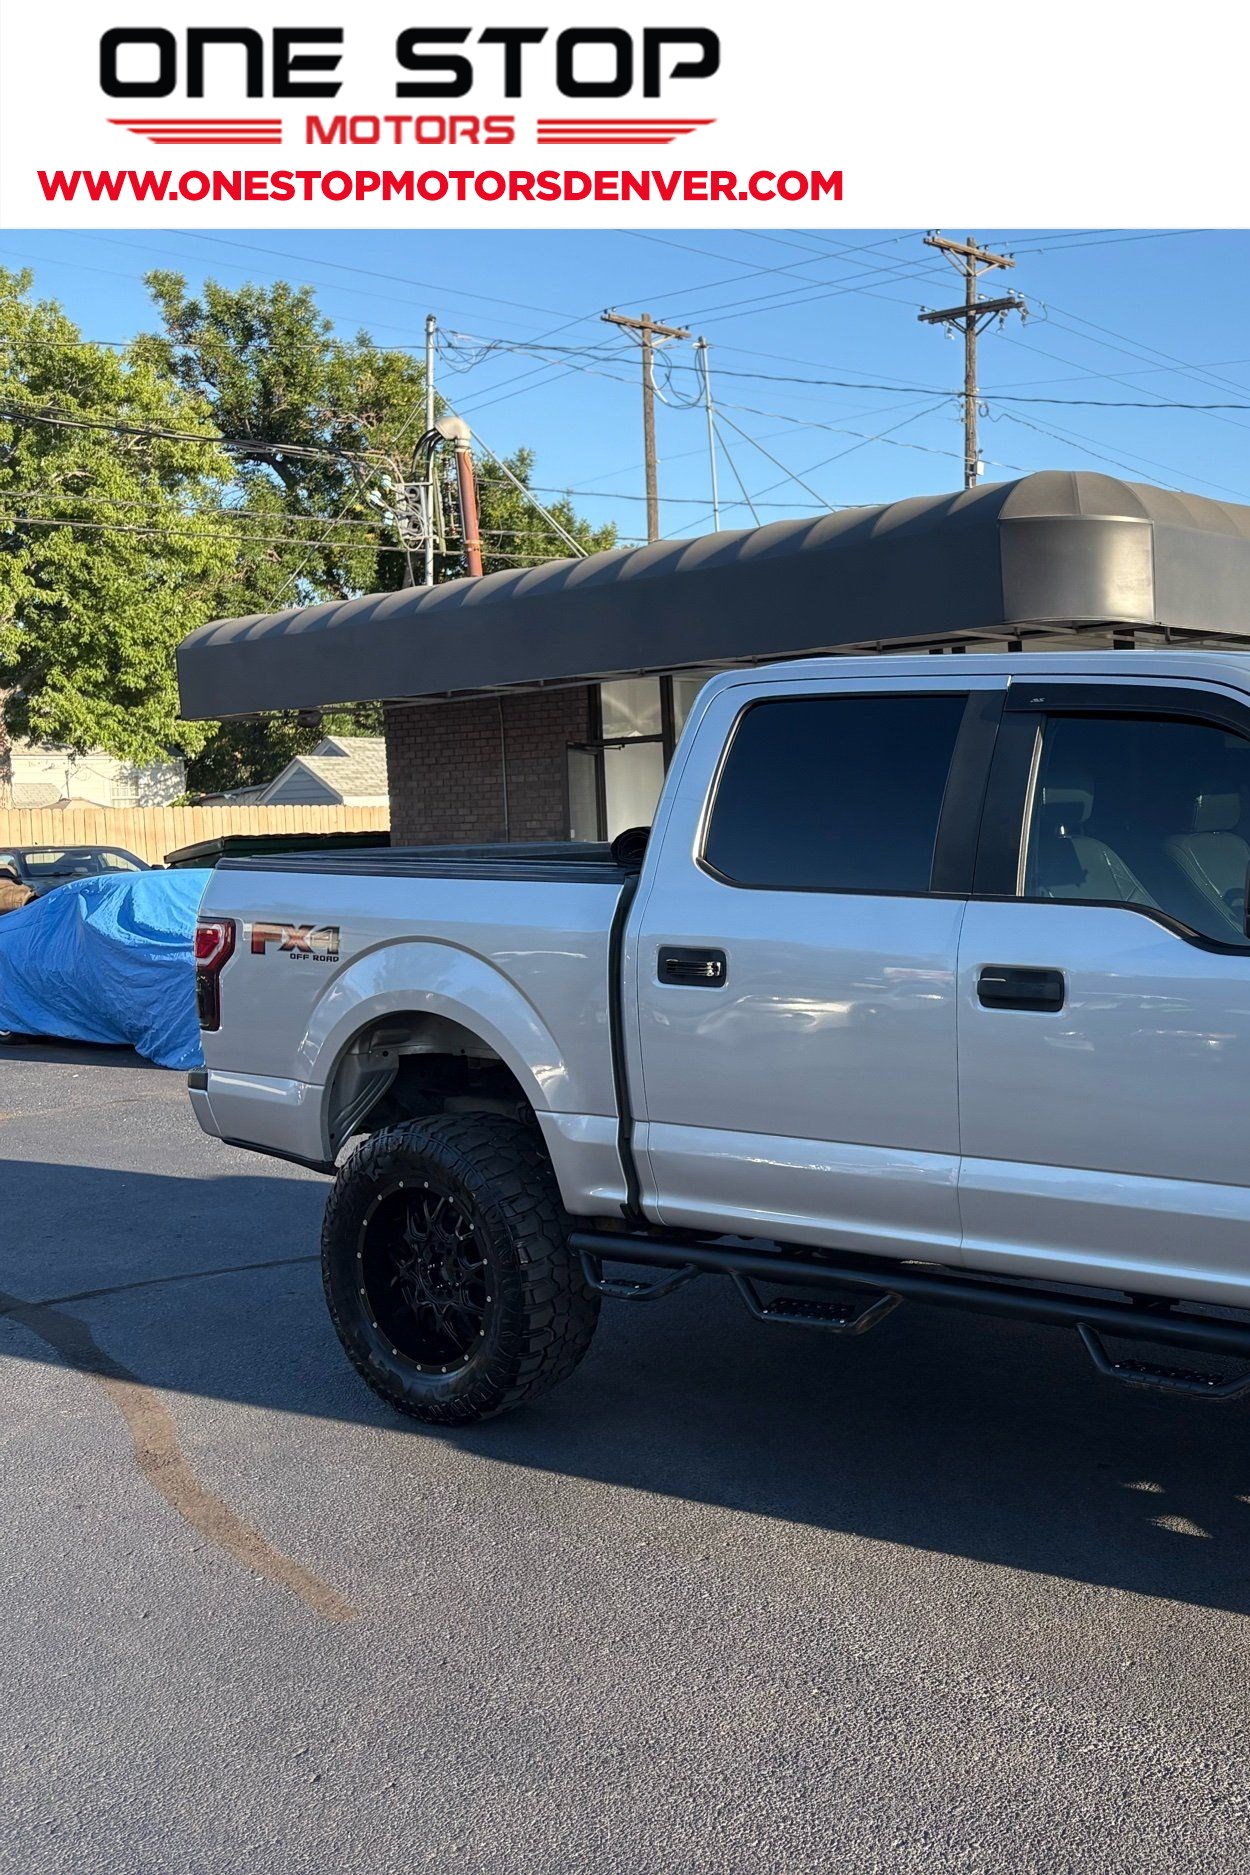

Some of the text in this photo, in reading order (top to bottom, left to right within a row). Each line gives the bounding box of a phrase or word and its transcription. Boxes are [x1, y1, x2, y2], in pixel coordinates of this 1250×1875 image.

[251, 922, 340, 955] FX4
[289, 952, 339, 963] OFF ROAD
